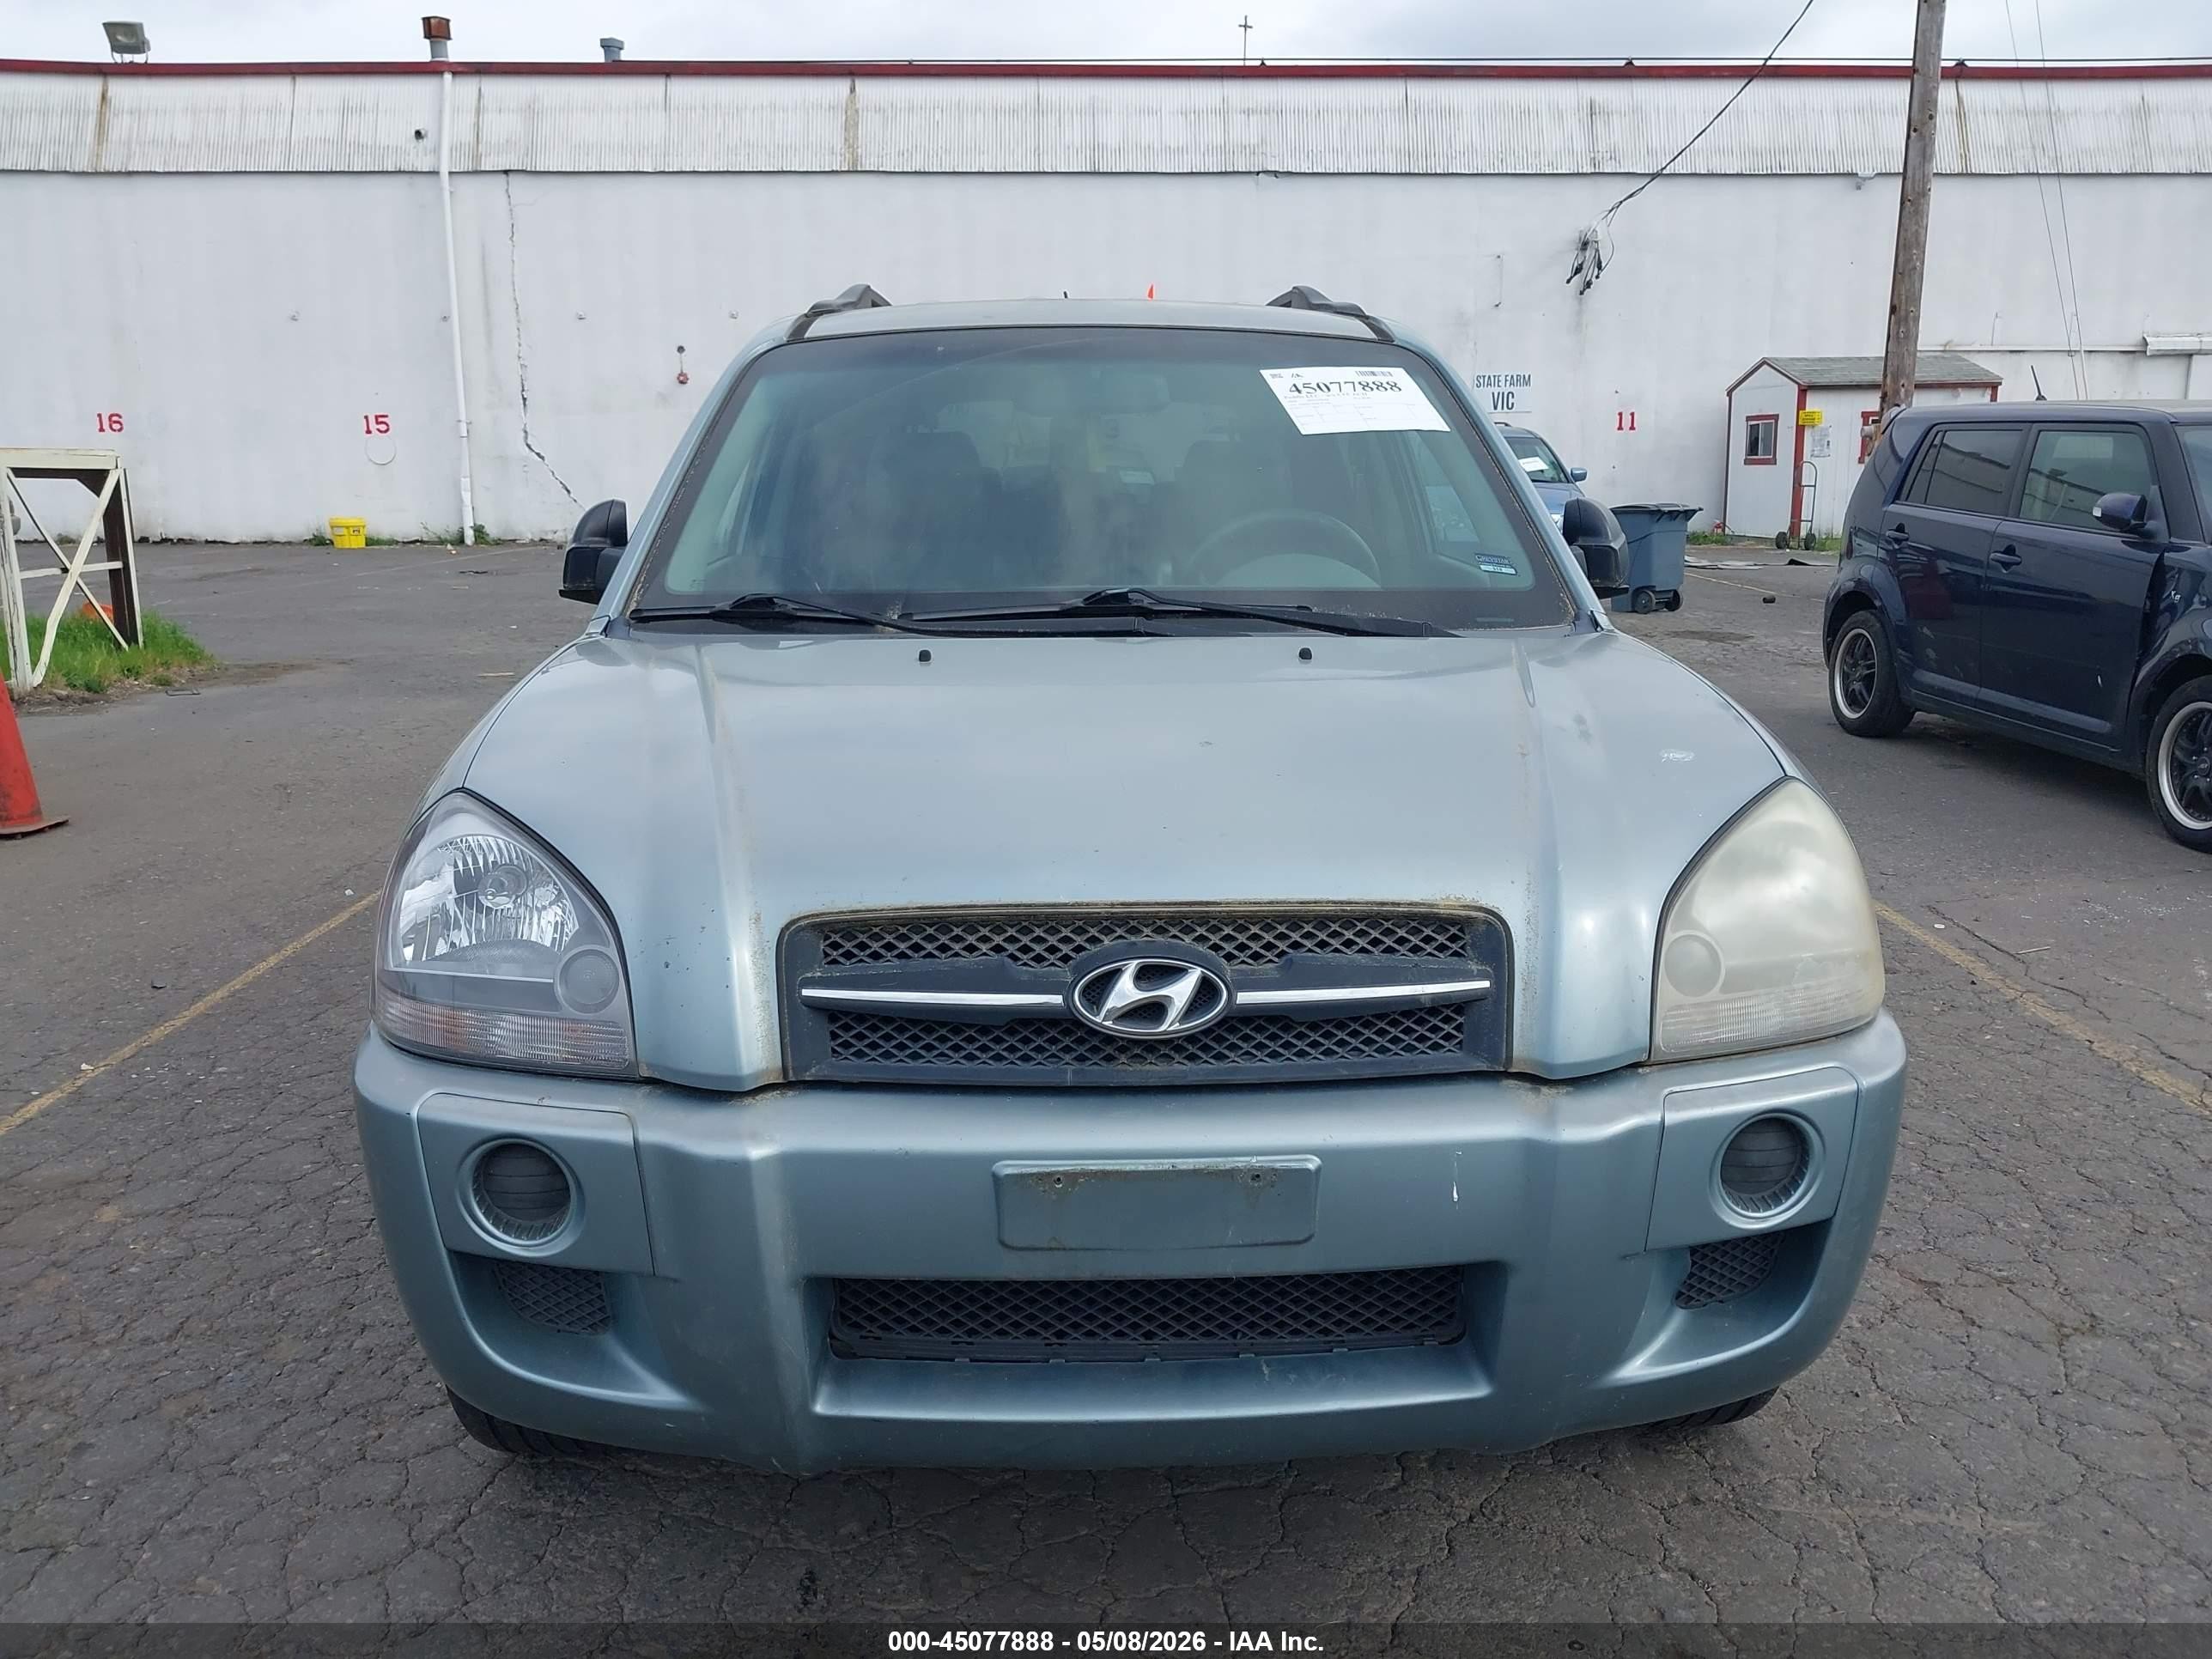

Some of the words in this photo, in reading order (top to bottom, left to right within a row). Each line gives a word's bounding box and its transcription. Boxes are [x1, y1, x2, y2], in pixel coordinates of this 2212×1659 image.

[1289, 380, 1403, 394] 45077888
[1475, 374, 1502, 388] STATE
[1504, 374, 1531, 387] FARM
[1492, 391, 1515, 410] VIC
[96, 413, 125, 433] 16
[363, 414, 390, 434] 15
[1617, 411, 1636, 430] 11
